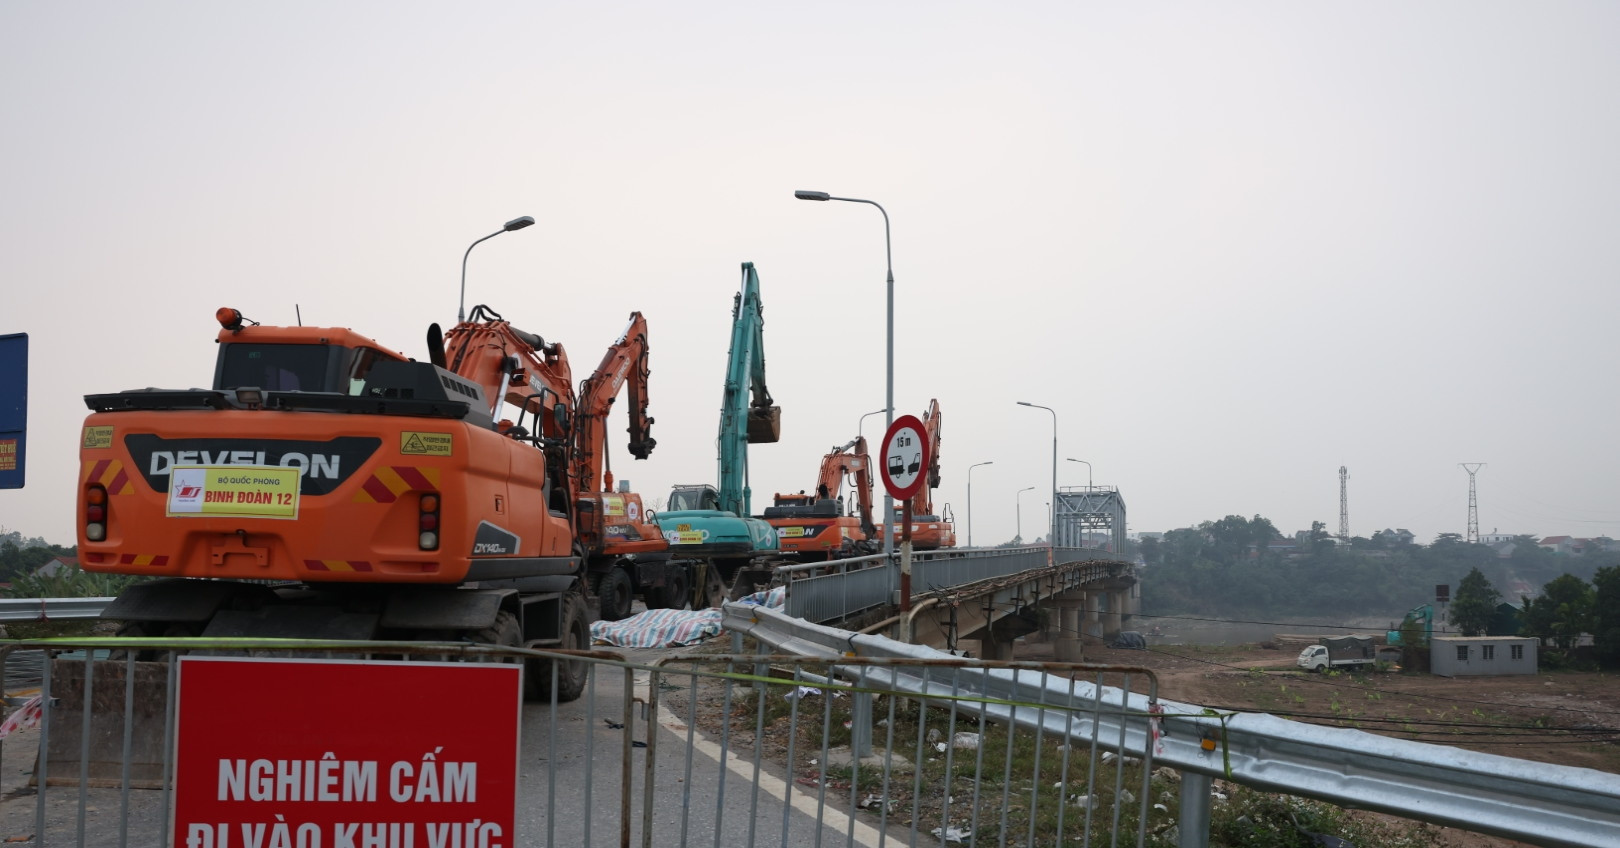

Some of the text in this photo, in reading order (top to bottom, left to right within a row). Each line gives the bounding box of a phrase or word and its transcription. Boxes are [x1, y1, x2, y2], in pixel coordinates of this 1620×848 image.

[897, 436, 911, 448] 15 m
[230, 475, 251, 485] QUỐC
[204, 489, 293, 505] BINH ĐOÀN 12
[217, 746, 478, 803] NGHIÊM CẤM
[186, 822, 230, 848] ĐI
[240, 813, 322, 848] VÀO
